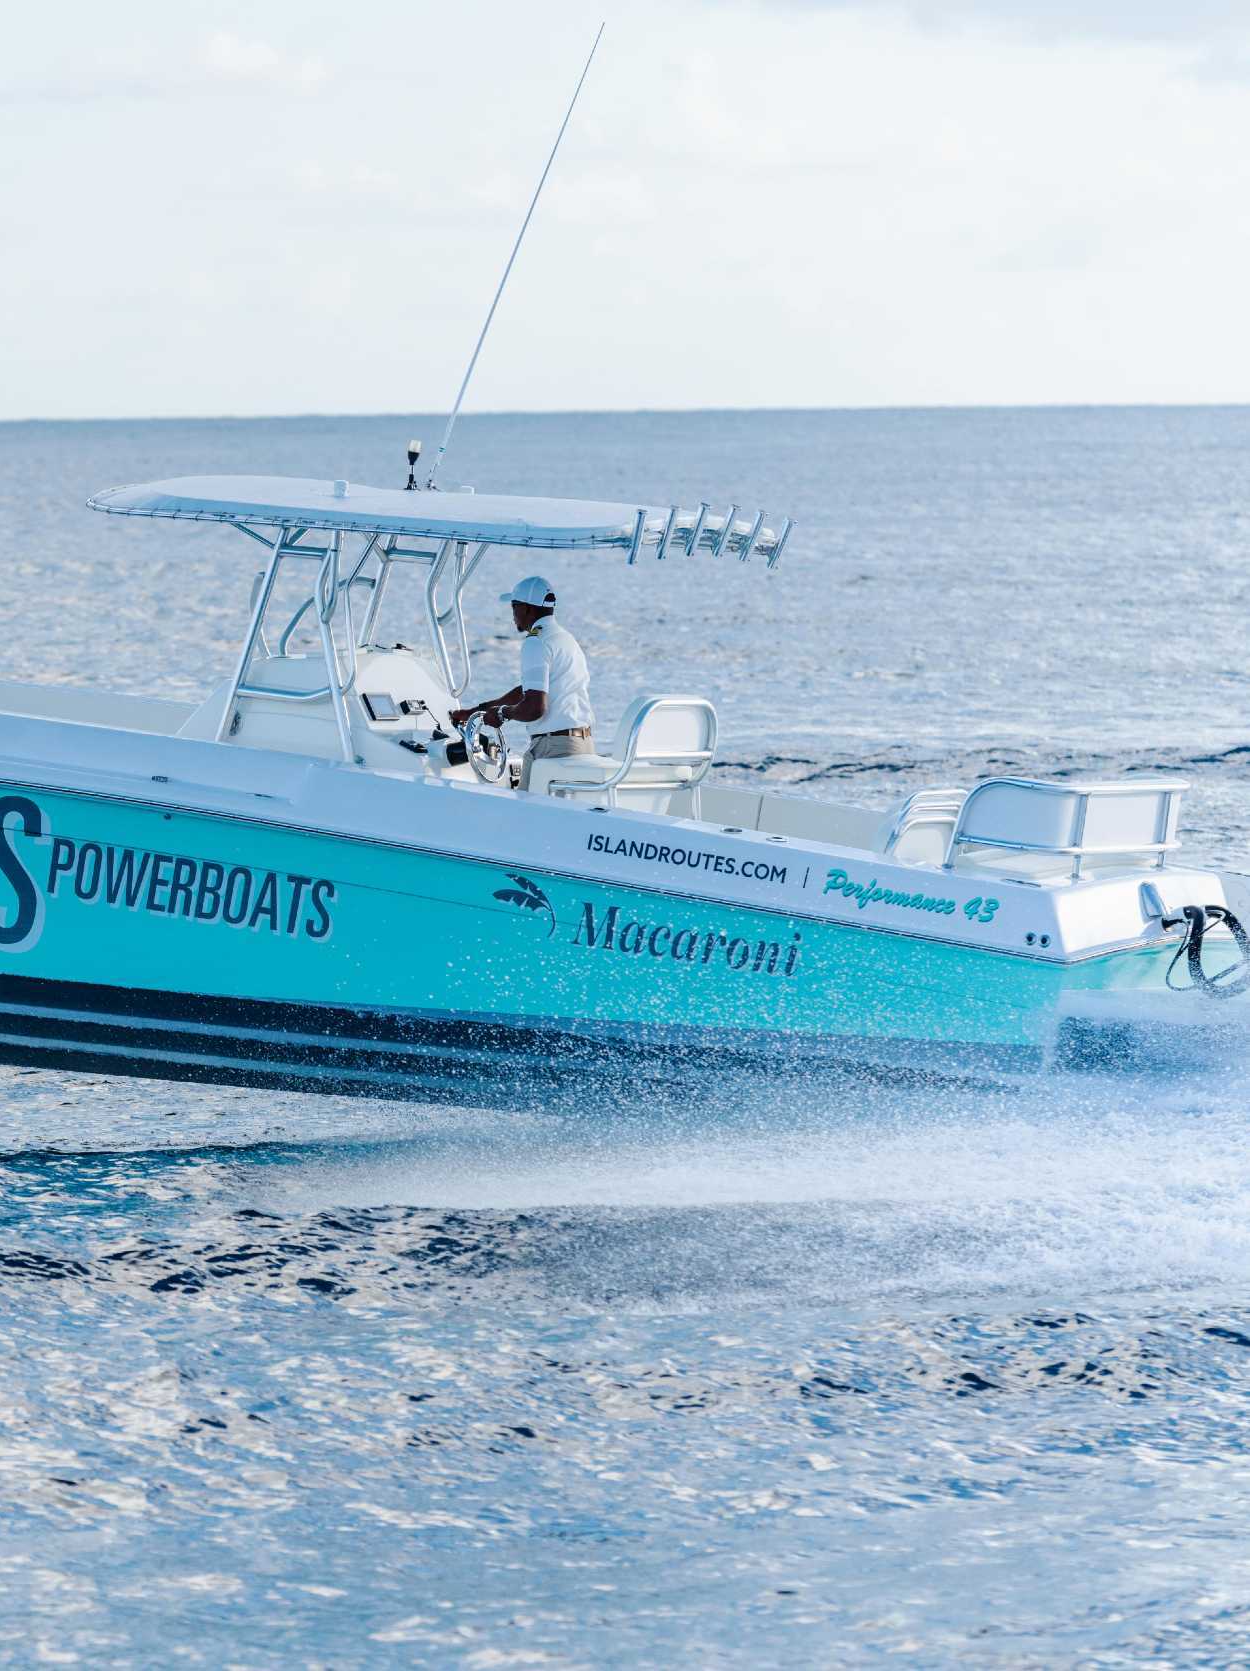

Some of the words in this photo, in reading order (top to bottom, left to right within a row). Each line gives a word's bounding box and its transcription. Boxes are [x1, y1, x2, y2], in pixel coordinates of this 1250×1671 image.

[46, 837, 336, 939] POWERBOATS
[586, 833, 788, 885] ISLANDROUTES.COM
[822, 867, 956, 916] Performance
[962, 896, 1001, 923] 43
[571, 902, 805, 978] Macaroni
